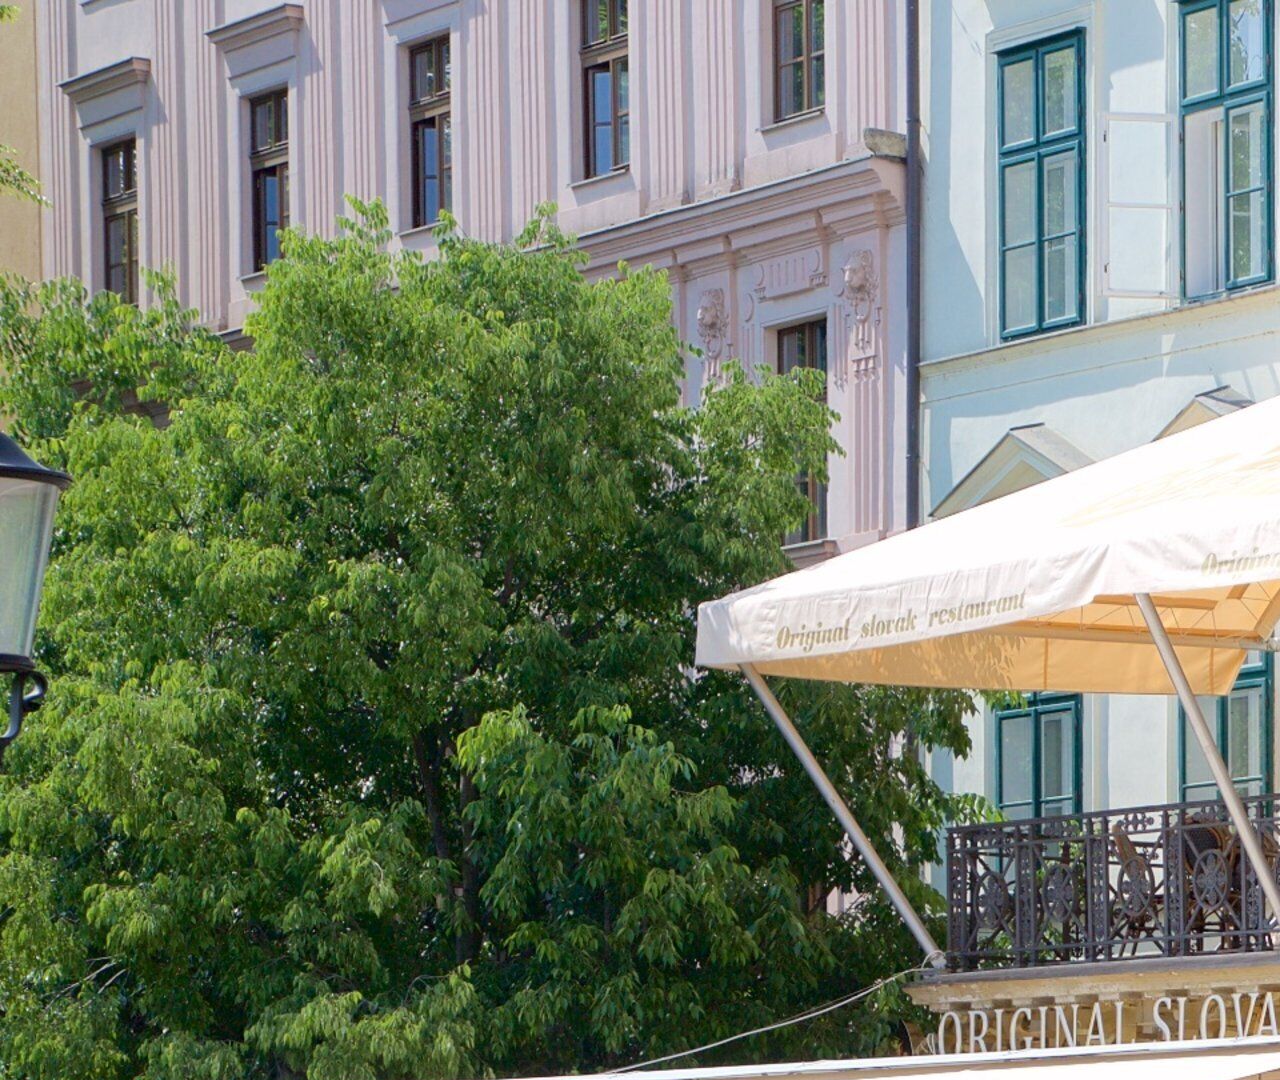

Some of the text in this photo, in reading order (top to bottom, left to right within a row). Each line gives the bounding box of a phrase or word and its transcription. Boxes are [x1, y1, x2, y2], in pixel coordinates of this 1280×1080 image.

[776, 591, 1026, 653] Original slovak restaurant
[938, 1001, 1137, 1055] ORIGINAL
